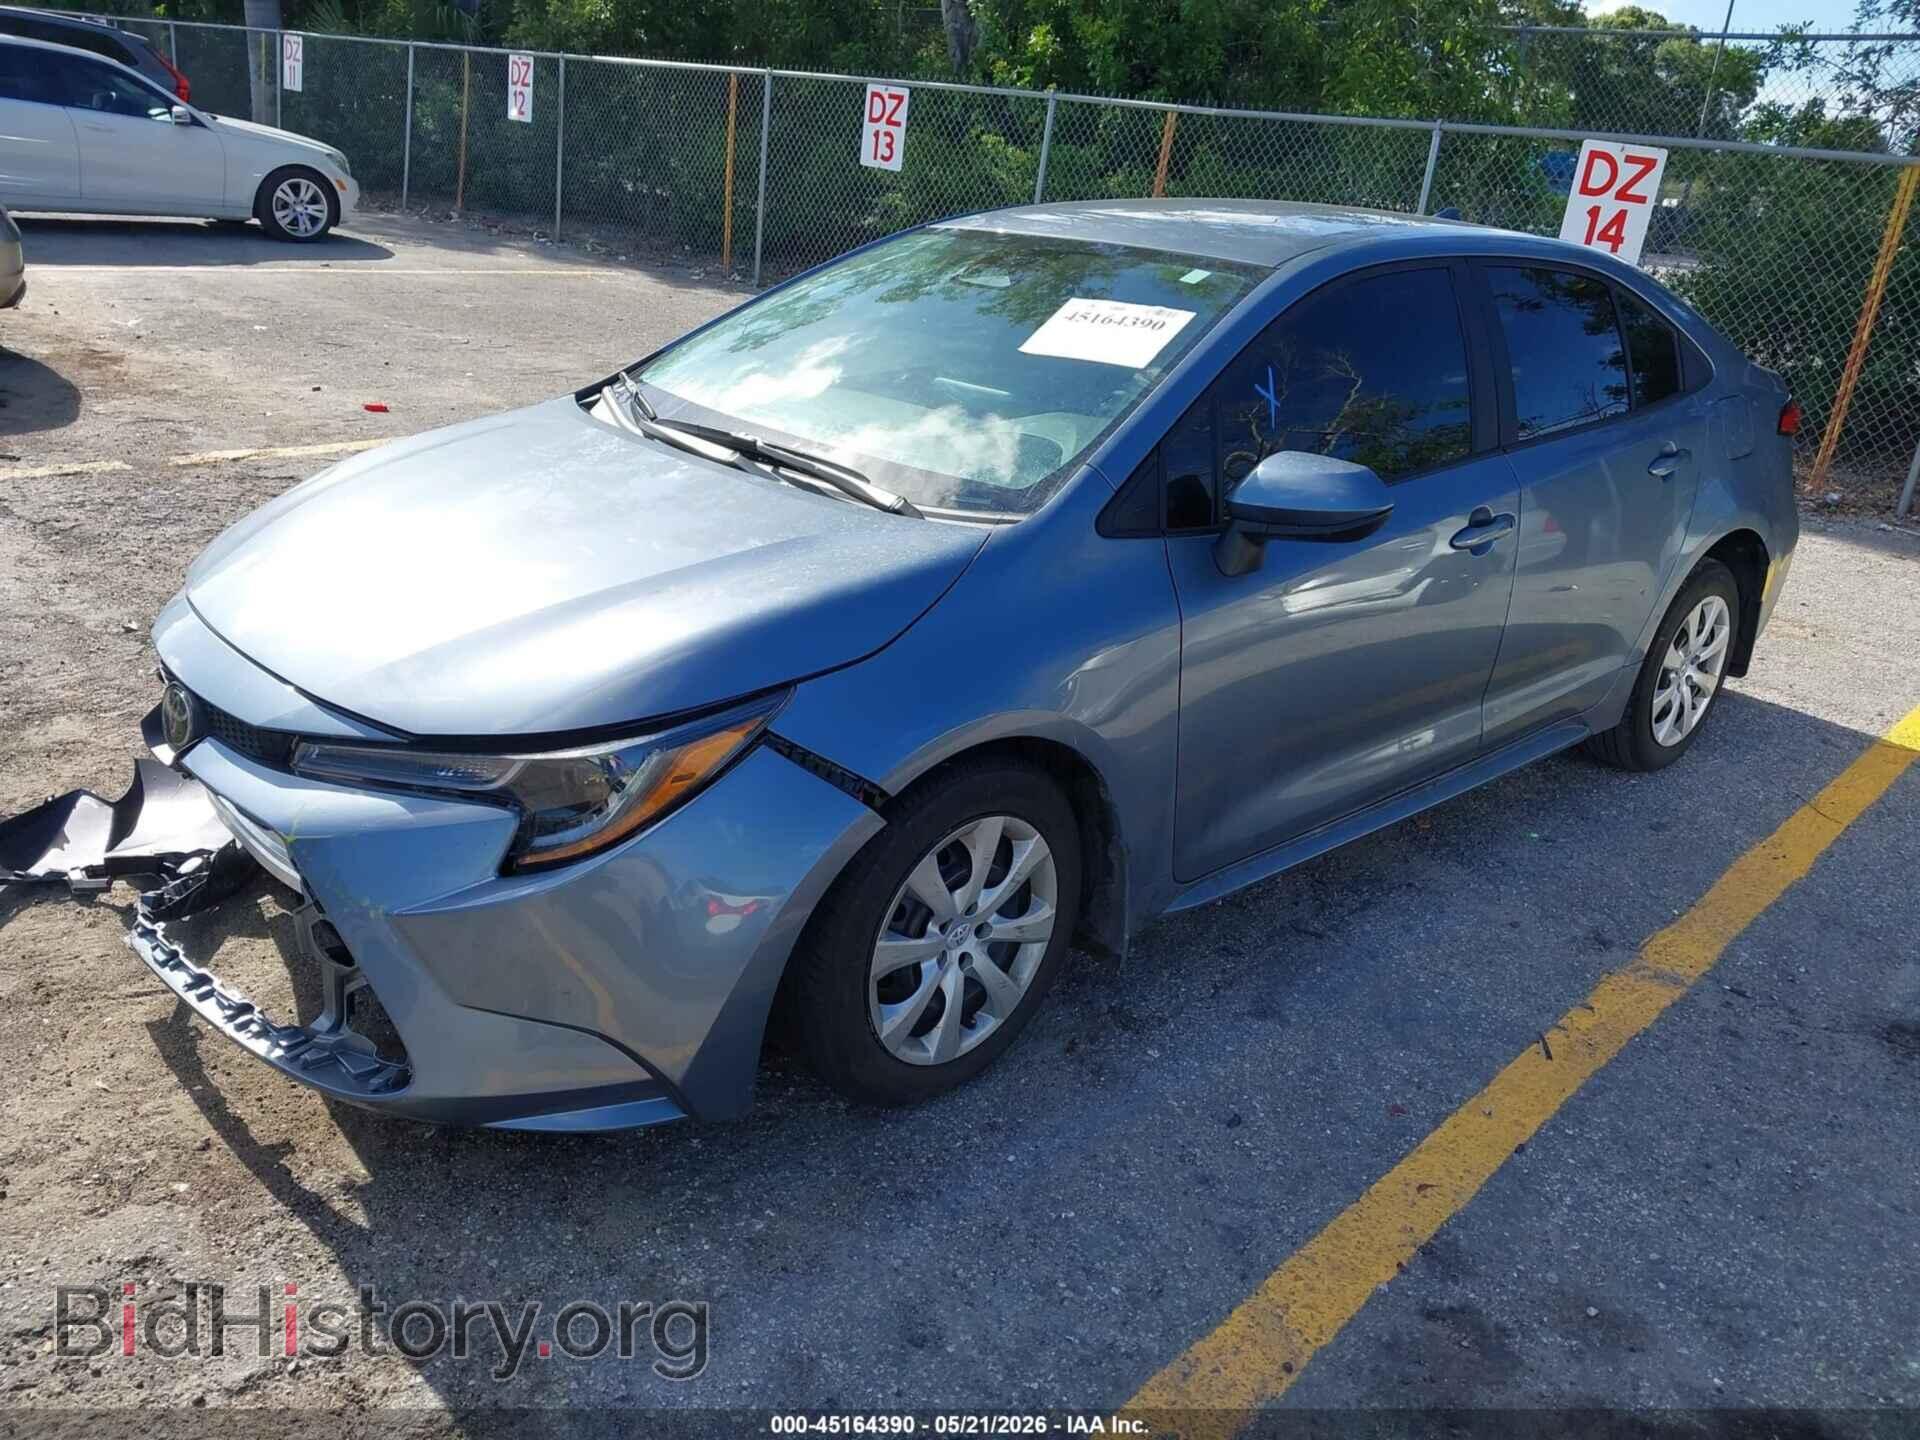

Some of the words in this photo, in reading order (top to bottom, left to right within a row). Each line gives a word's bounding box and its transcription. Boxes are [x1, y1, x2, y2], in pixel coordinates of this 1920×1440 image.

[286, 39, 301, 62] DZ
[288, 65, 296, 87] 11
[511, 60, 531, 87] DZ
[513, 90, 525, 115] 12
[868, 91, 905, 127] DZ
[873, 129, 895, 161] 13
[1578, 150, 1658, 204] DZ
[1584, 205, 1628, 253] 14
[1064, 310, 1167, 331] 45164390
